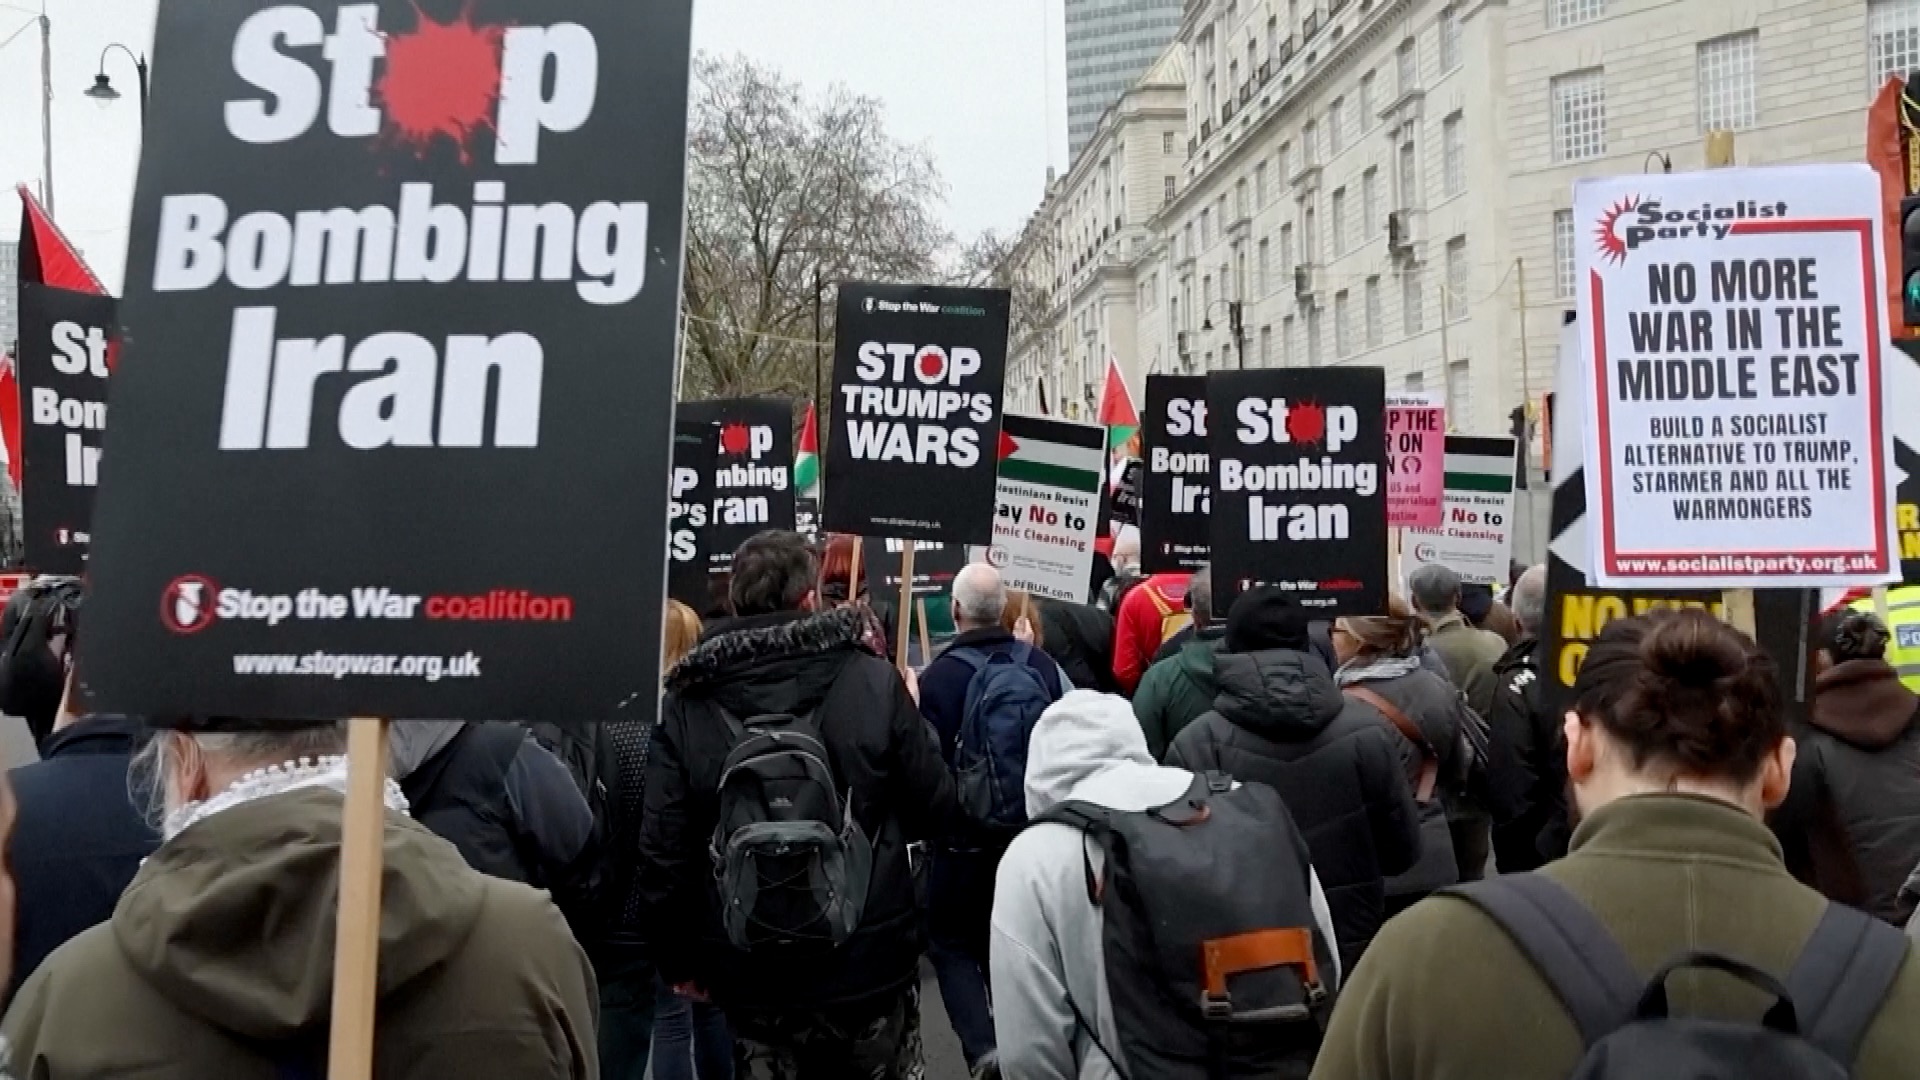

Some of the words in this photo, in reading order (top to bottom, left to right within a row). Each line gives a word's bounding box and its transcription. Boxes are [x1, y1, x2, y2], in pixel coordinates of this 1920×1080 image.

[1637, 200, 1788, 224] Socialist
[153, 181, 649, 304] Bombing
[1648, 263, 1696, 304] NO
[1711, 258, 1818, 303] MORE
[903, 301, 918, 312] the
[1628, 309, 1714, 353] WAR
[1726, 307, 1762, 350] IN
[1775, 305, 1843, 349] THE
[51, 320, 109, 378] St
[856, 341, 981, 386] STOP
[219, 306, 544, 450] Iran
[1617, 356, 1758, 401] MIDDLE
[1770, 353, 1860, 397] EAST
[841, 384, 993, 423] TRUMP'S
[1166, 398, 1208, 436] St
[1405, 410, 1437, 431] THE
[1650, 416, 1704, 438] BUILD
[1711, 415, 1724, 436] A
[1731, 413, 1828, 436] SOCIALIST
[846, 420, 980, 468] WARS
[1400, 433, 1422, 453] ON
[1624, 441, 1746, 466] ALTERNATIVE
[1753, 442, 1776, 464] TO
[1784, 440, 1859, 464] TRUMP,
[65, 433, 102, 486] Ir
[1219, 456, 1377, 496] Bombing
[1632, 470, 1723, 494] STARMER
[1730, 469, 1768, 491] AND
[1776, 468, 1810, 491] ALL
[1816, 467, 1852, 490] THE
[713, 496, 768, 525] ran
[995, 503, 1023, 524] ay
[1029, 504, 1058, 525] No
[1065, 512, 1085, 531] to
[1248, 496, 1349, 540] Iran
[1452, 508, 1477, 523] No
[1484, 511, 1502, 526] to
[1673, 496, 1813, 521] WARMONGERS
[995, 524, 1020, 538] hnic
[1024, 528, 1086, 552] Cleansing
[1448, 528, 1504, 544] Cleansing
[1616, 555, 1877, 574] www.socialistparty.org.uk
[216, 588, 291, 625] Stop
[296, 588, 349, 619] the
[351, 587, 421, 618] War
[424, 590, 573, 620] coalition
[233, 651, 481, 681] www.stopwar.org.uk
